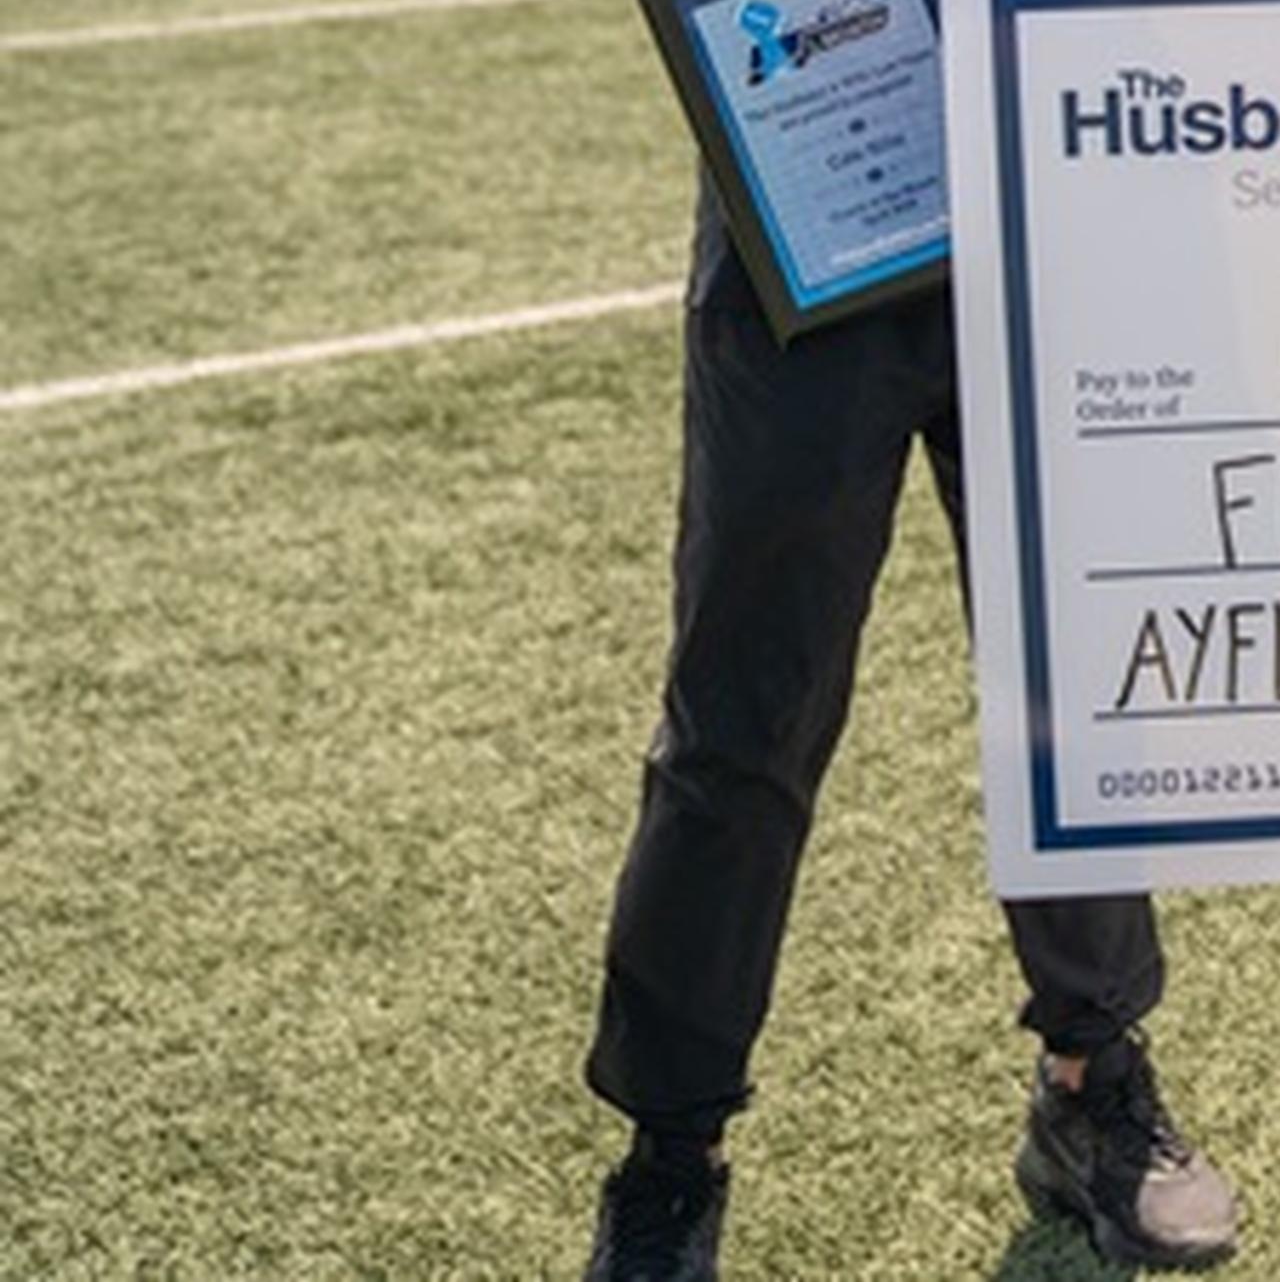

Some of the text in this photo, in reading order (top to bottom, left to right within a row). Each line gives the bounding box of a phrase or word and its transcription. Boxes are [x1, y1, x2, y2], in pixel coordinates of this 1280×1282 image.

[1118, 69, 1187, 100] The
[1076, 369, 1119, 398] Pay
[1076, 396, 1147, 421] Order
